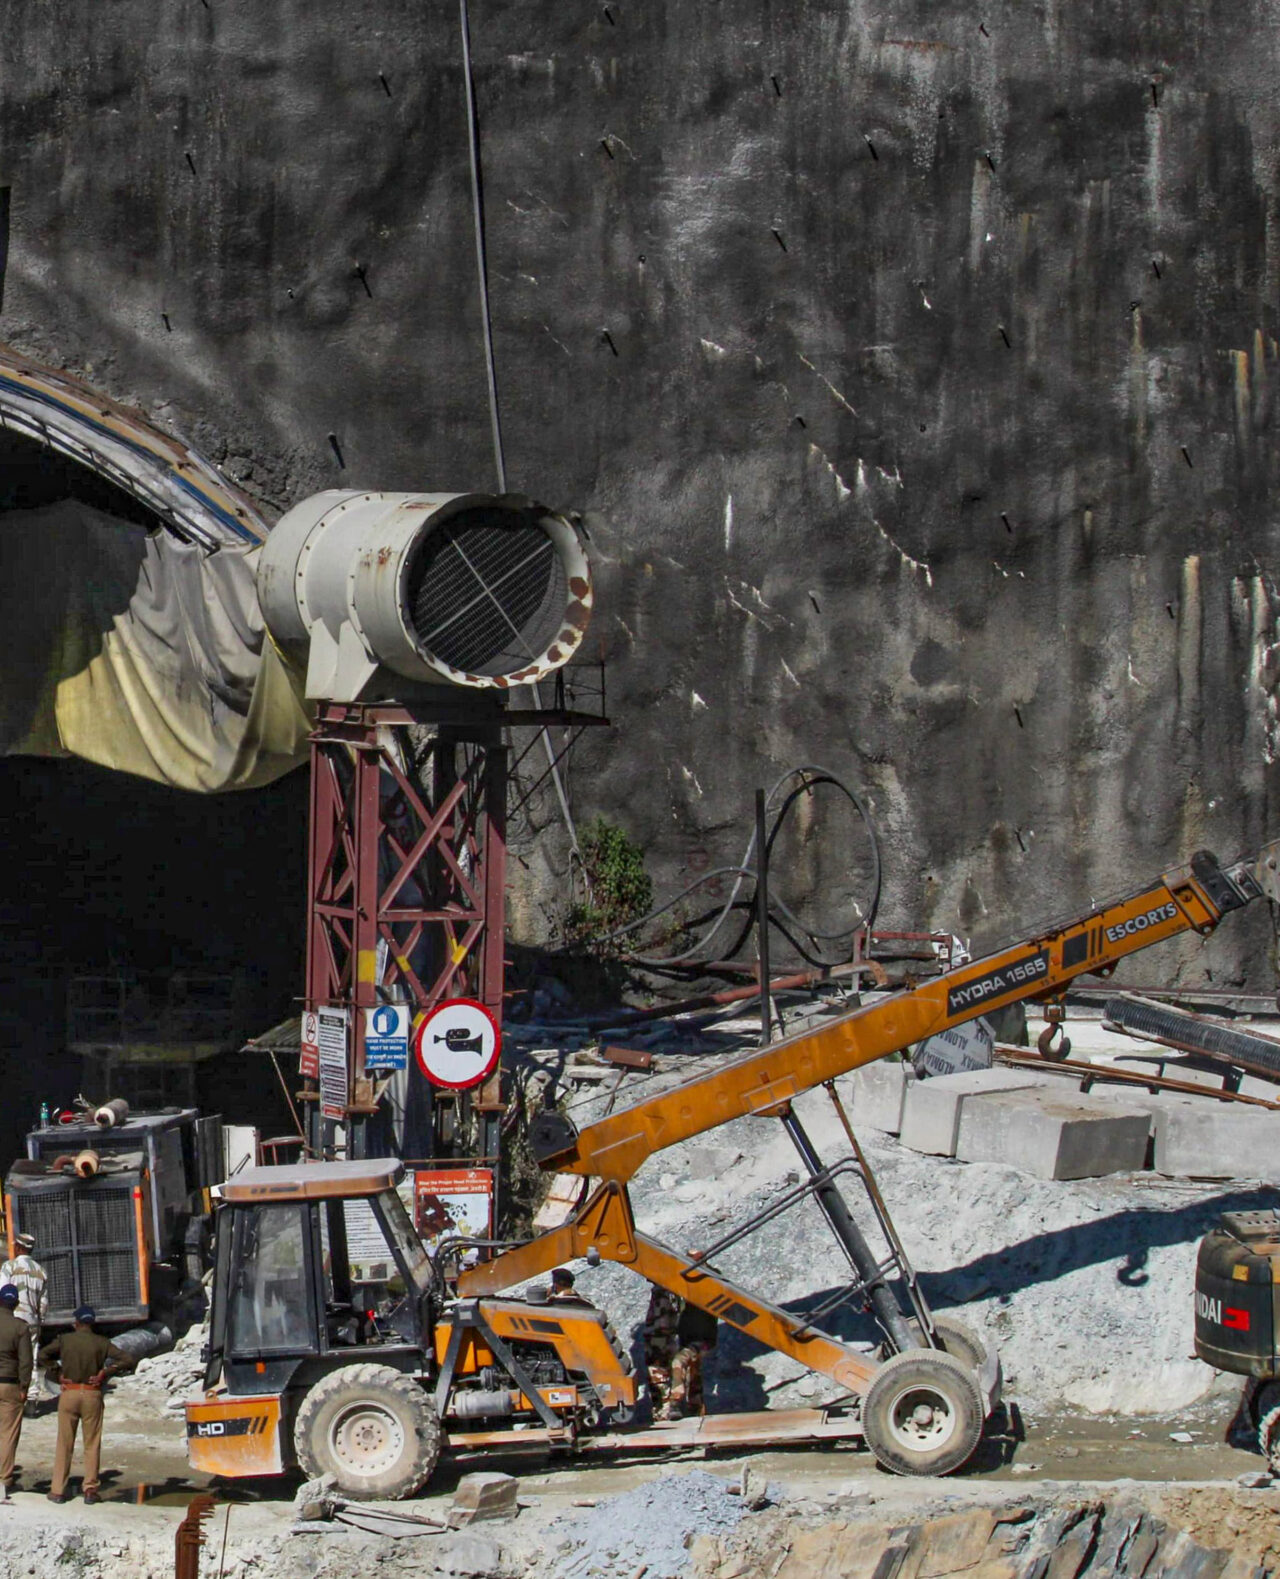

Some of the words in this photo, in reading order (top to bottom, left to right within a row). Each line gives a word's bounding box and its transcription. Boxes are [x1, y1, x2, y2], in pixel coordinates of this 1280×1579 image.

[1106, 903, 1177, 942] ESCORTS
[949, 976, 1006, 1008] HYDRA
[1006, 958, 1046, 982] 1565
[937, 1030, 968, 1051] ALOMA
[197, 1422, 225, 1436] HD
